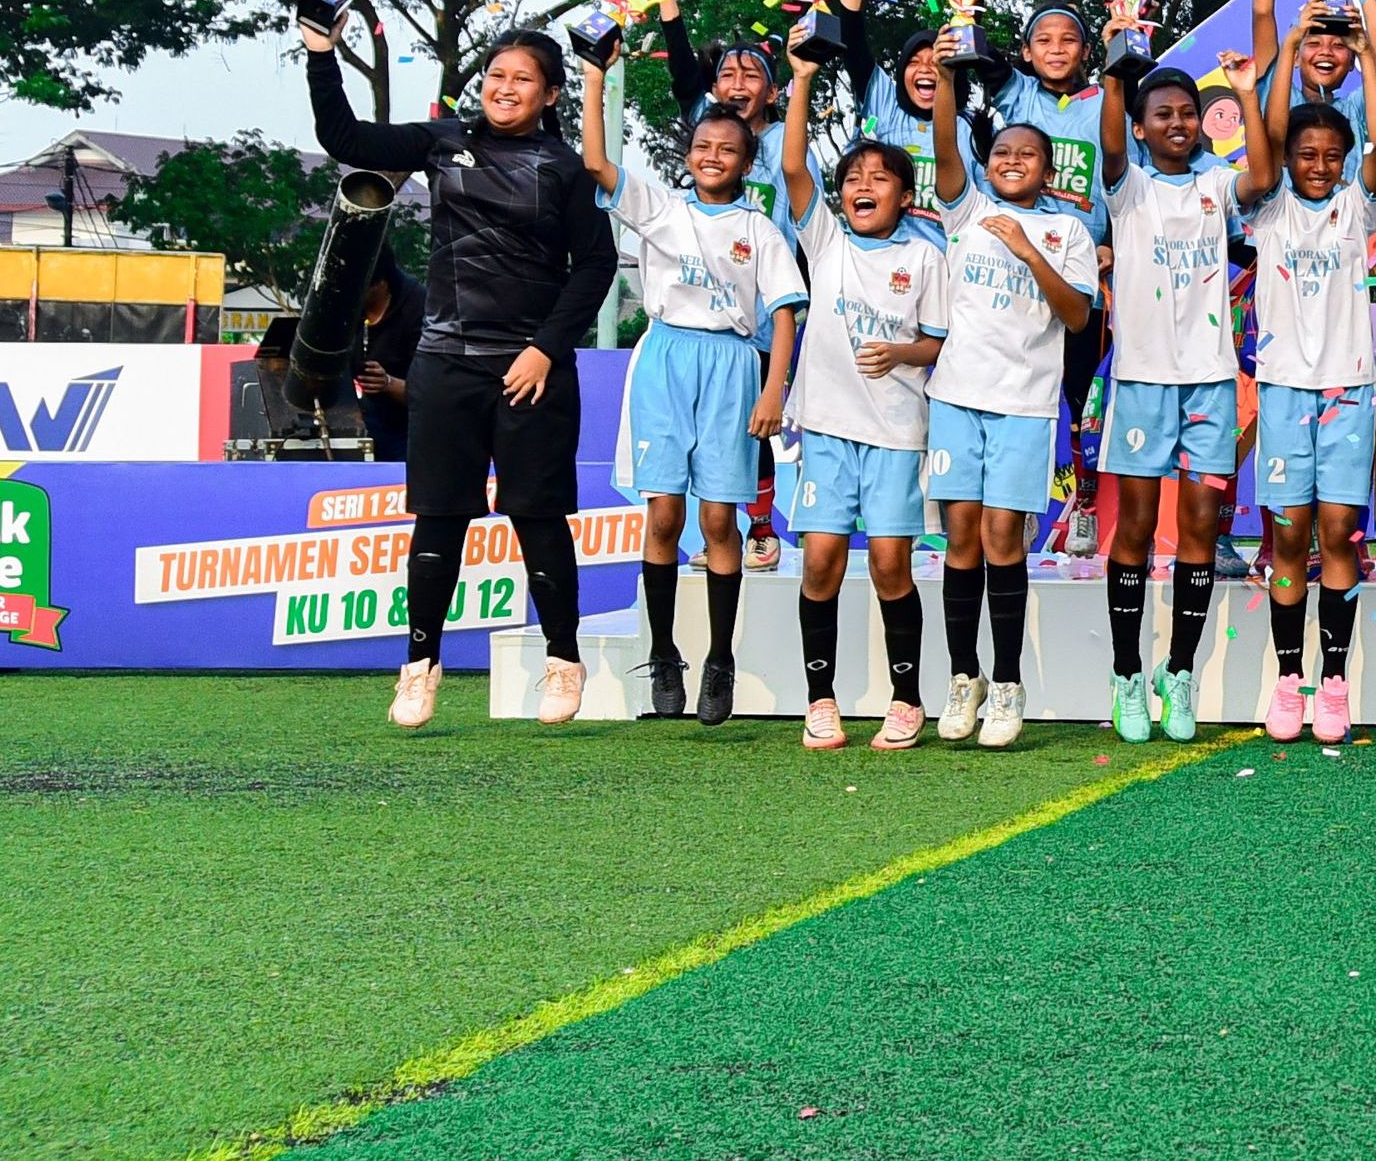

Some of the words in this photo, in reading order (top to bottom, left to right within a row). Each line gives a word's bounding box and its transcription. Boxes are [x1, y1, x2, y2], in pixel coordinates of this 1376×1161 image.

[992, 292, 1011, 311] 19
[1126, 427, 1146, 454] 9
[636, 441, 650, 469] 7
[928, 449, 952, 476] 10
[1267, 457, 1286, 484] 2
[321, 493, 364, 522] SERI
[370, 492, 379, 517] 1
[802, 481, 817, 508] 8
[159, 538, 340, 593] TURNAMEN
[350, 532, 411, 576] SEP
[465, 523, 525, 567] BOL
[567, 513, 645, 557] PUTR
[286, 593, 330, 636] KU
[341, 588, 378, 631] 10
[388, 586, 409, 627] &
[478, 577, 516, 620] 12
